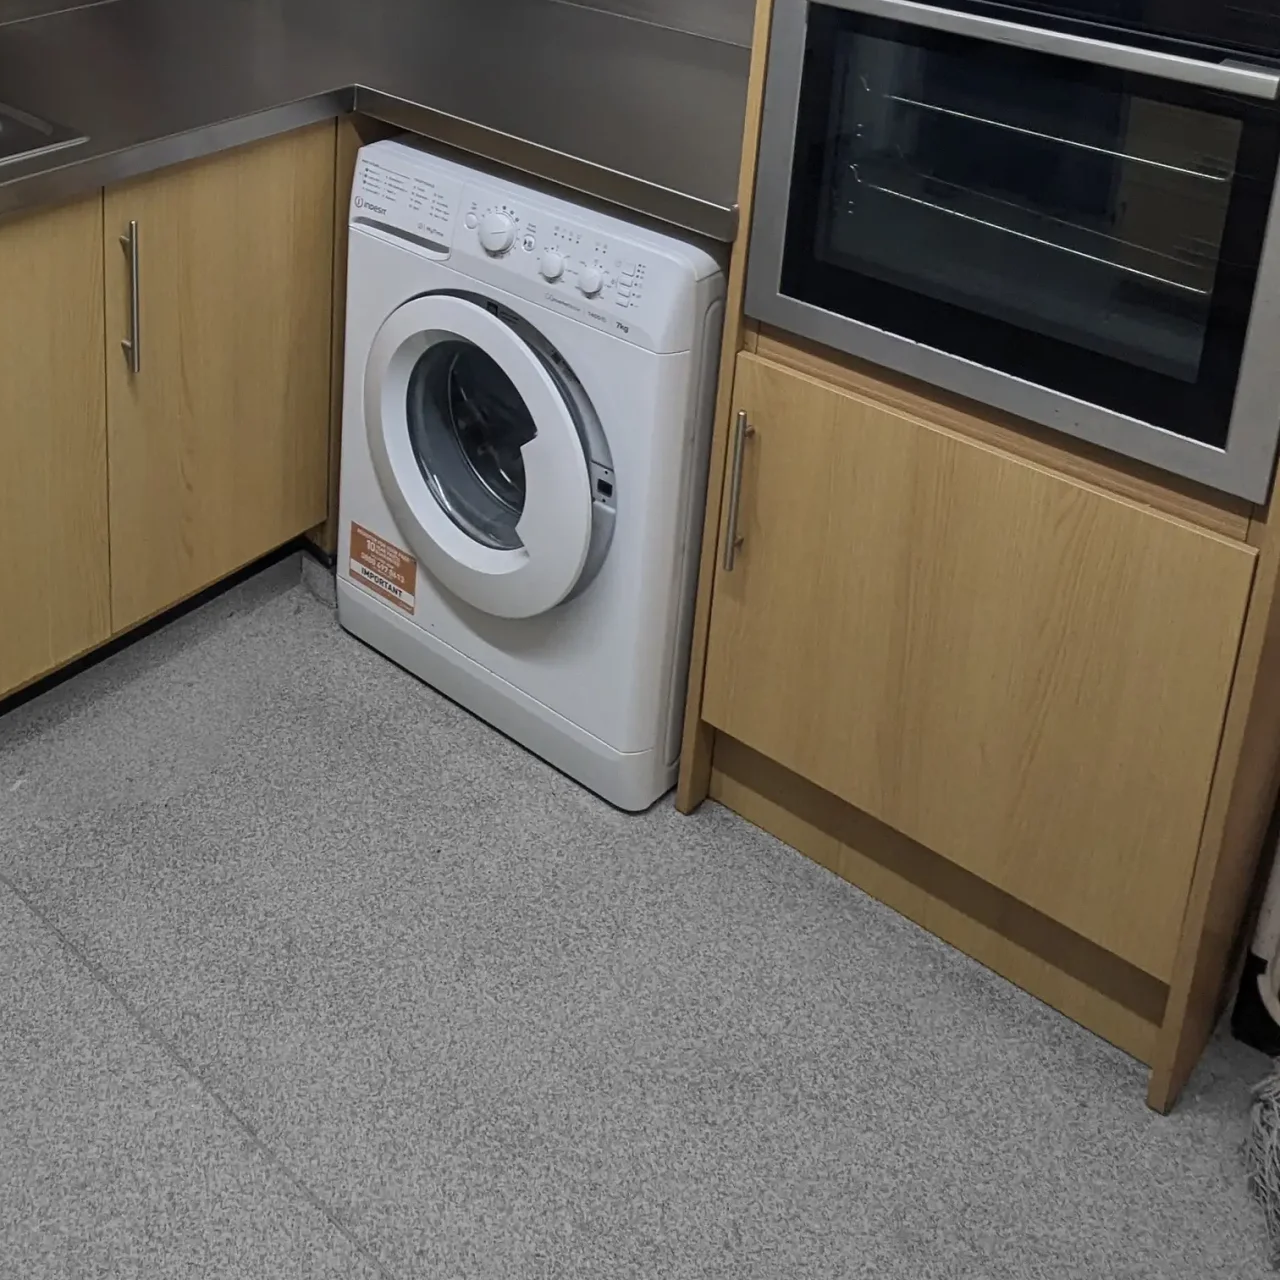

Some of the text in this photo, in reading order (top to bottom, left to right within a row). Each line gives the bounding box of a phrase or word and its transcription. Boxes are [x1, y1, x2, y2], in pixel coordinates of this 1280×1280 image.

[616, 321, 629, 334] 7kg
[366, 539, 376, 551] 10
[361, 566, 403, 597] IMPORTANT
